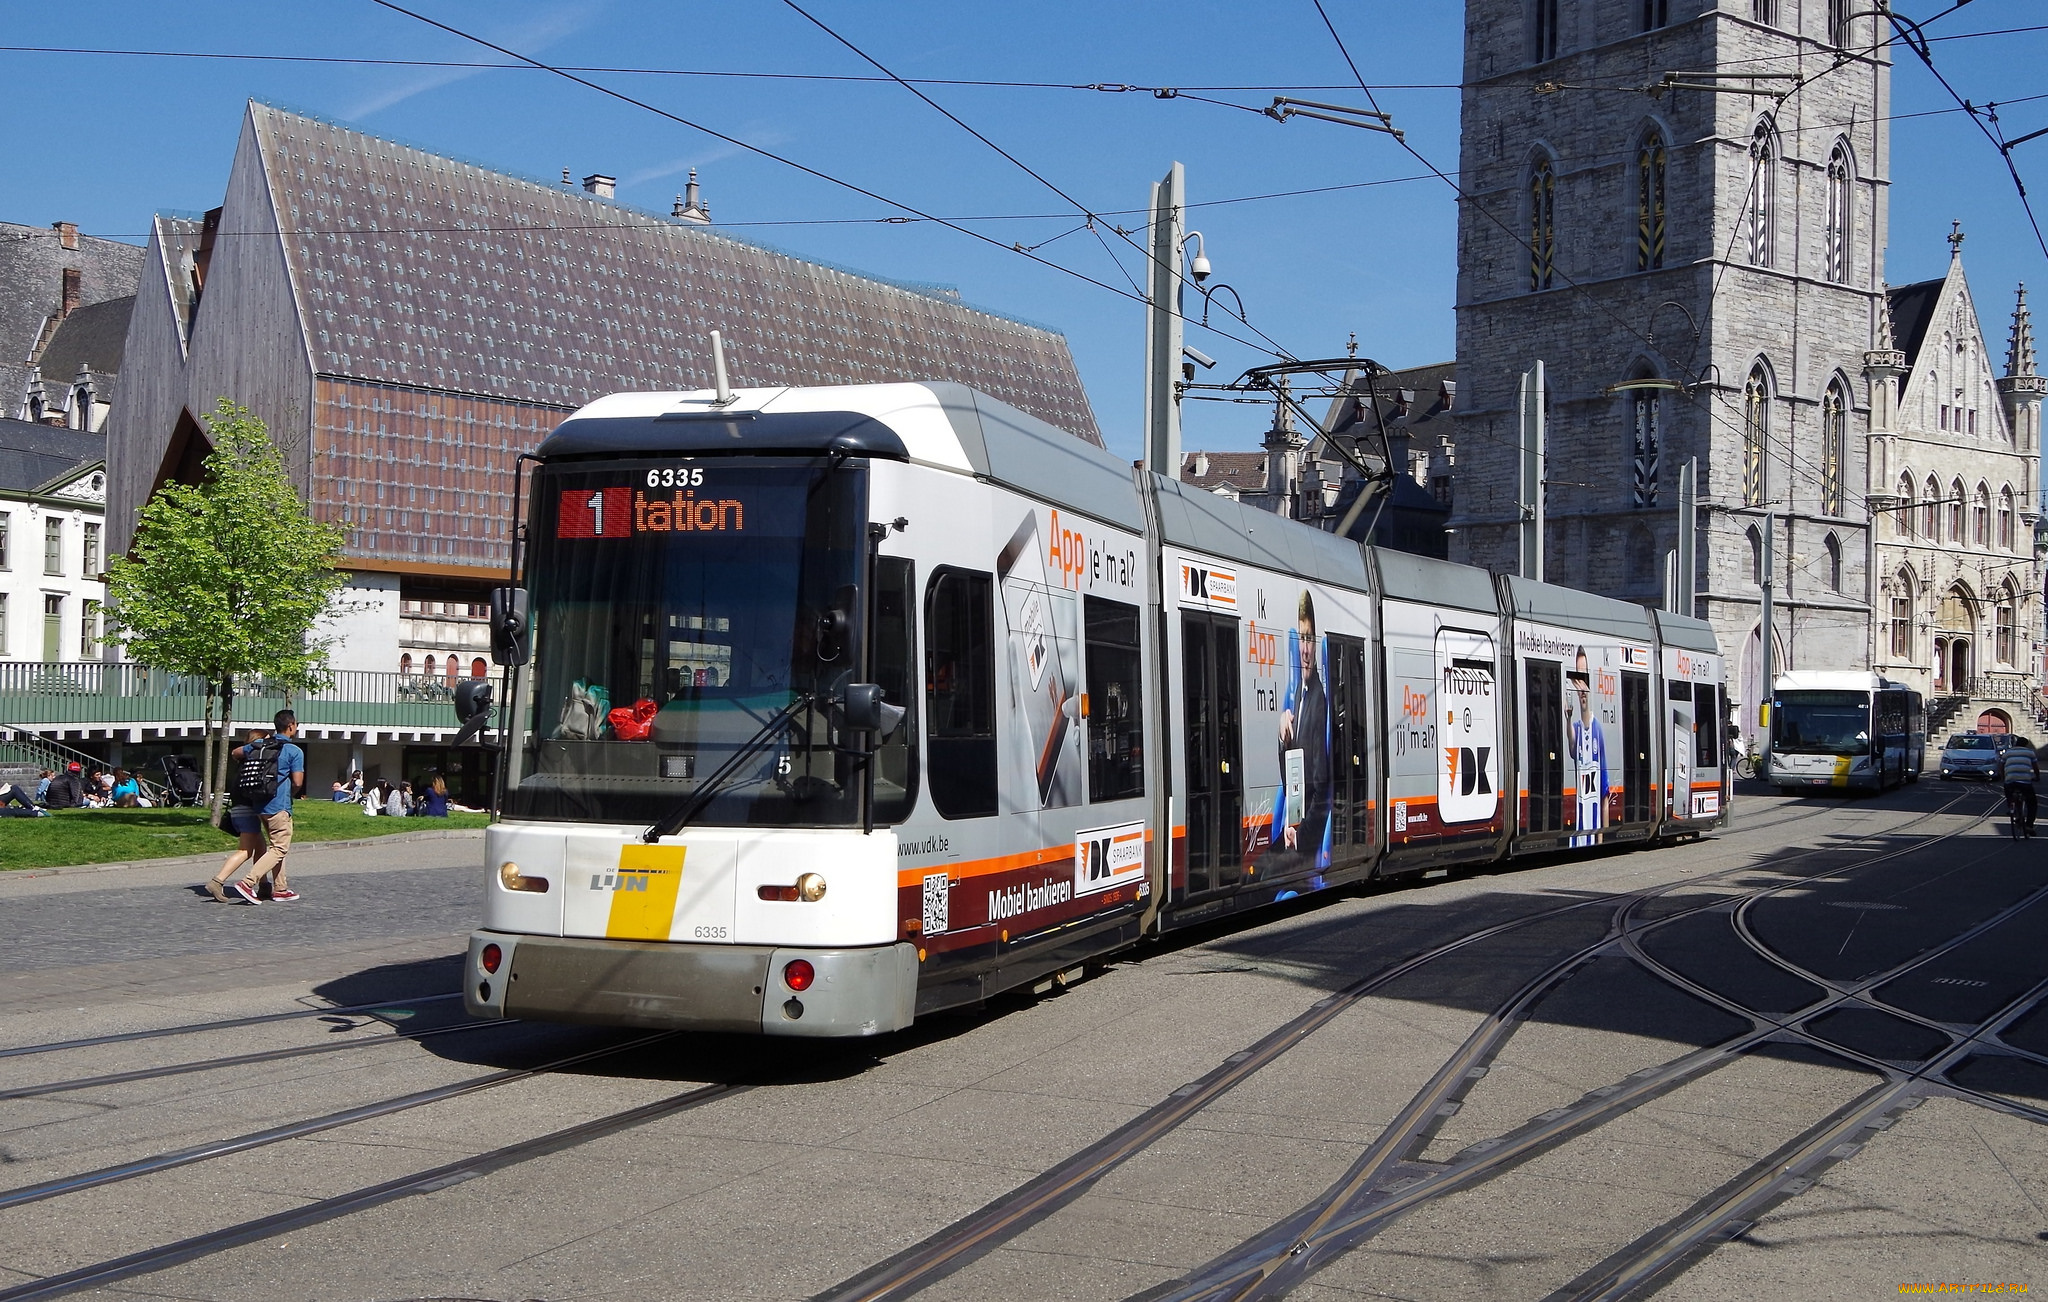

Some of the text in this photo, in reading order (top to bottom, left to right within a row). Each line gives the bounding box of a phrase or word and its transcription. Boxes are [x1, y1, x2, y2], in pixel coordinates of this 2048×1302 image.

[647, 468, 704, 487] 6335
[588, 490, 743, 535] 1 tation
[1049, 509, 1084, 591] App
[1089, 538, 1100, 589] je
[1120, 549, 1135, 588] al?
[1257, 588, 1267, 620] Ik
[1248, 620, 1276, 677] App
[1519, 631, 1575, 657] Mobiel bankieren
[1677, 650, 1690, 681] App
[1269, 682, 1278, 712] al
[1597, 667, 1615, 702] App
[1403, 684, 1428, 725] App
[1396, 724, 1406, 756] jij
[1422, 725, 1435, 750] al?
[778, 756, 791, 775] 5
[897, 835, 949, 857] www.vdk.be
[1112, 844, 1143, 864] SPAARBANK
[988, 877, 1071, 922] Mobiel bankieren
[694, 926, 727, 939] 6335
